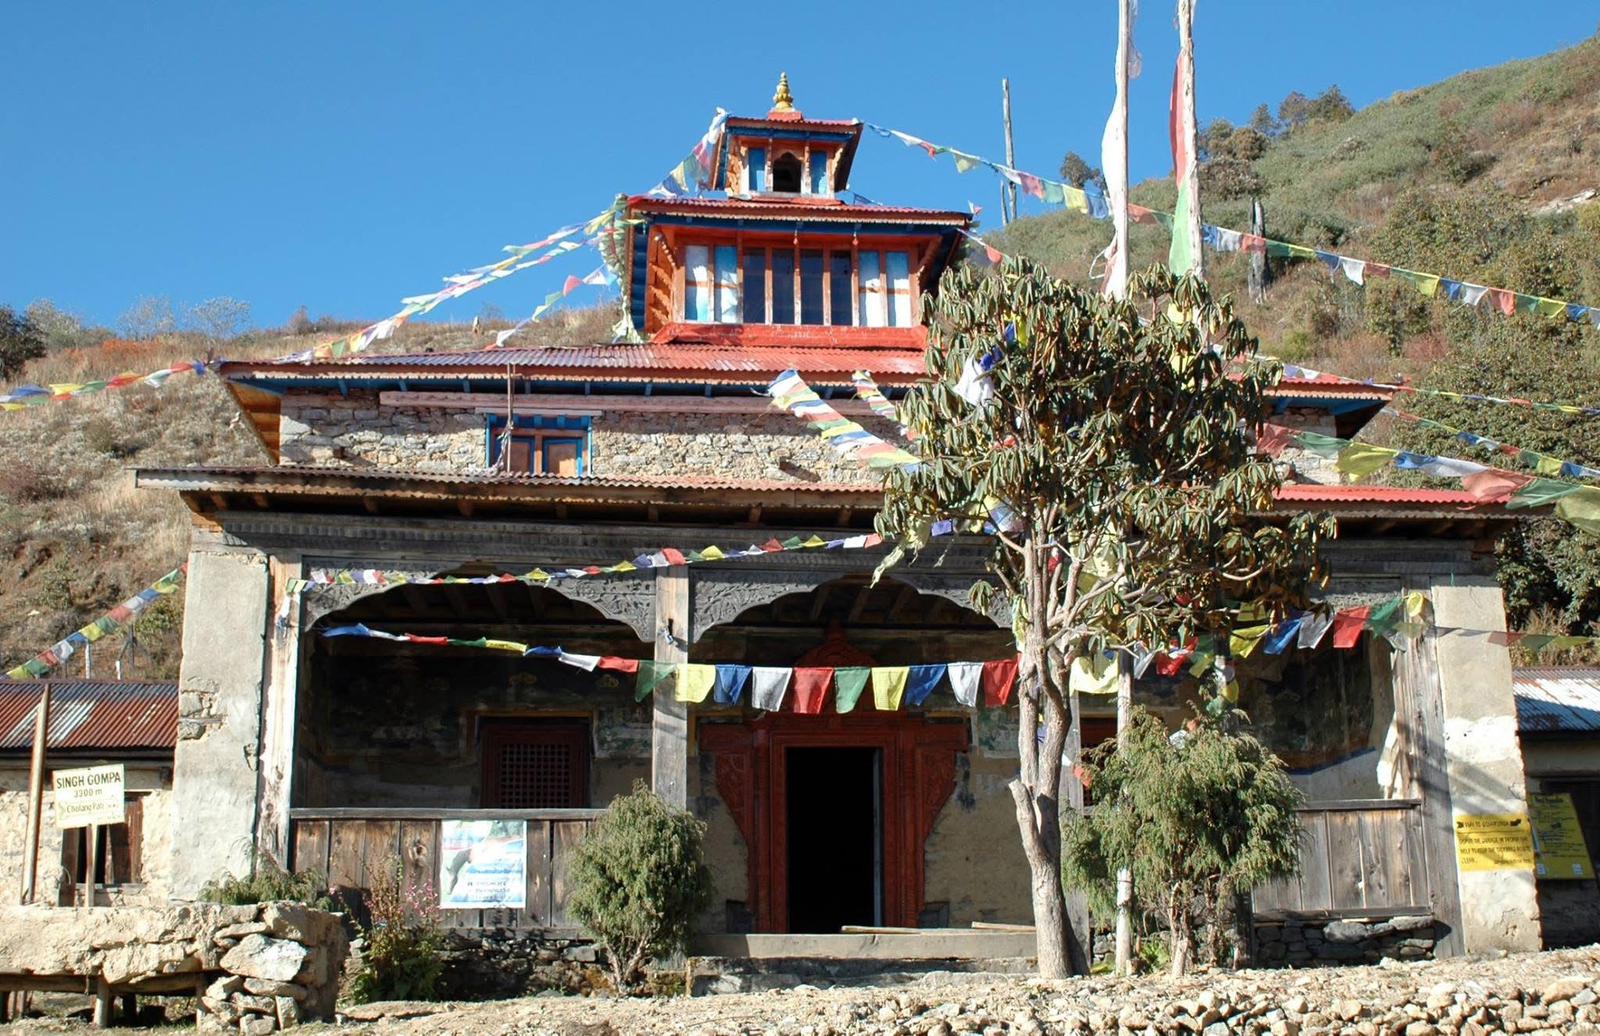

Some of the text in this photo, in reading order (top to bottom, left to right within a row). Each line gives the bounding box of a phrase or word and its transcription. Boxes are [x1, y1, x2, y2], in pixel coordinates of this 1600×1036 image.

[56, 772, 121, 789] SINGH GOMPA
[73, 788, 94, 798] 3300
